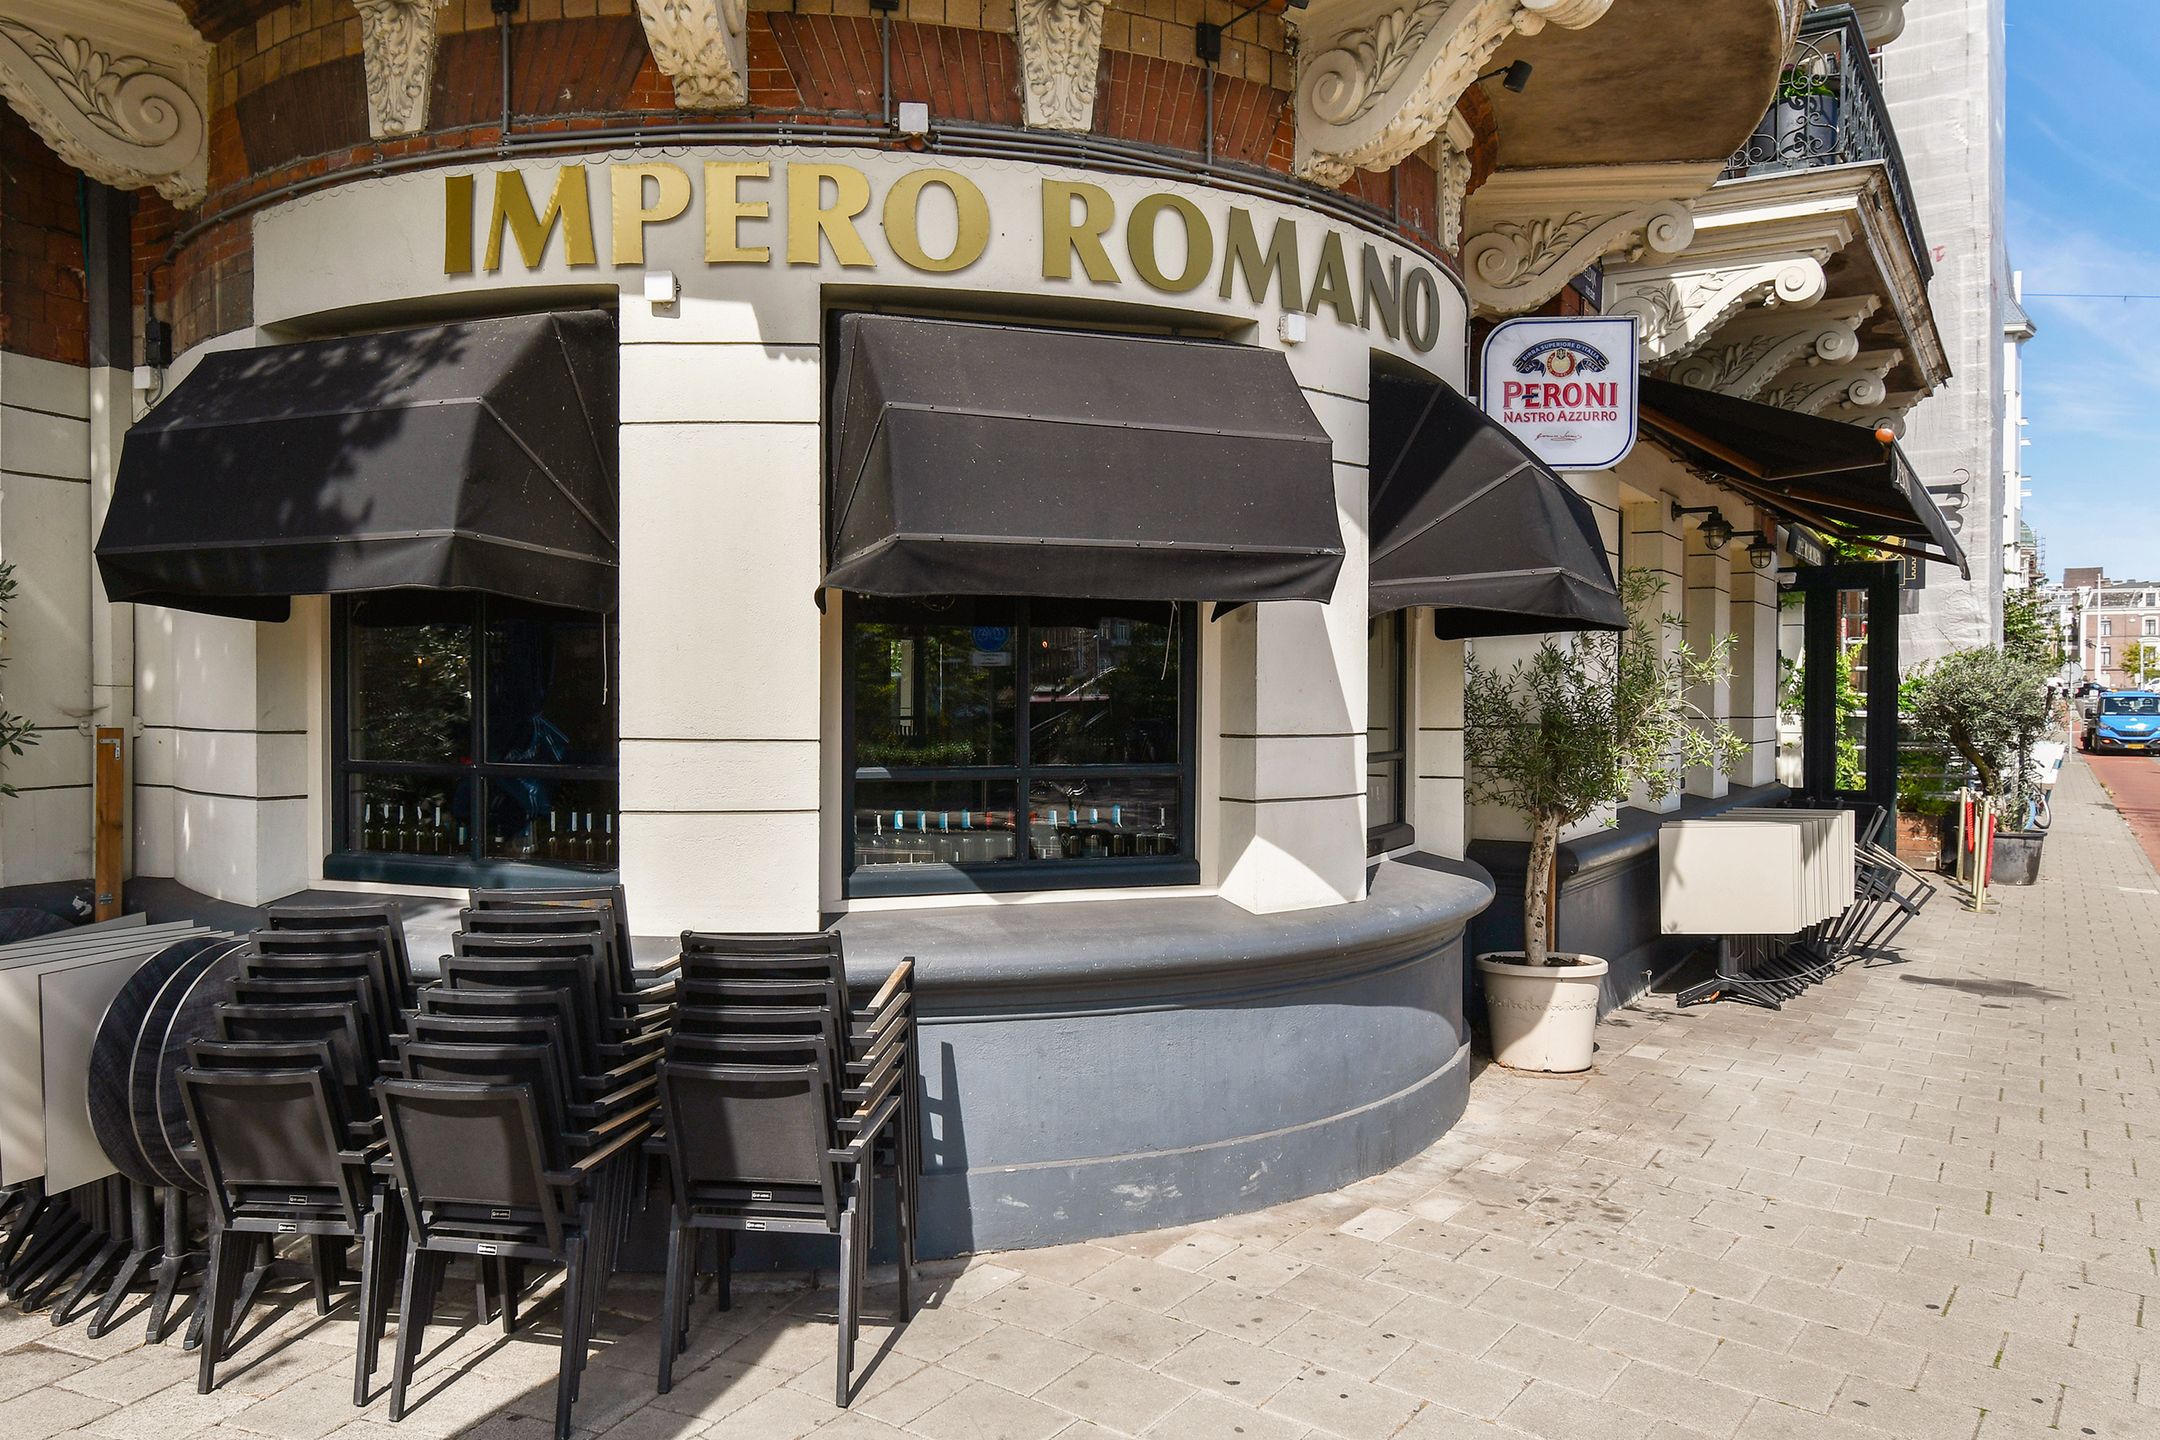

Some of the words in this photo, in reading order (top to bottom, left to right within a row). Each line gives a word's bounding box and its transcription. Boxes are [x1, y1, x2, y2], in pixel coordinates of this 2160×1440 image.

[444, 161, 990, 275] IMPERO
[1041, 178, 1440, 353] ROMANO
[1522, 347, 1541, 362] BIRRA
[1541, 342, 1575, 350] SUPERIORE
[1576, 342, 1600, 360] D'ITALIA
[1503, 381, 1619, 409] PERONI
[1503, 411, 1555, 423] NASTRO
[1557, 410, 1617, 422] AZZURRO
